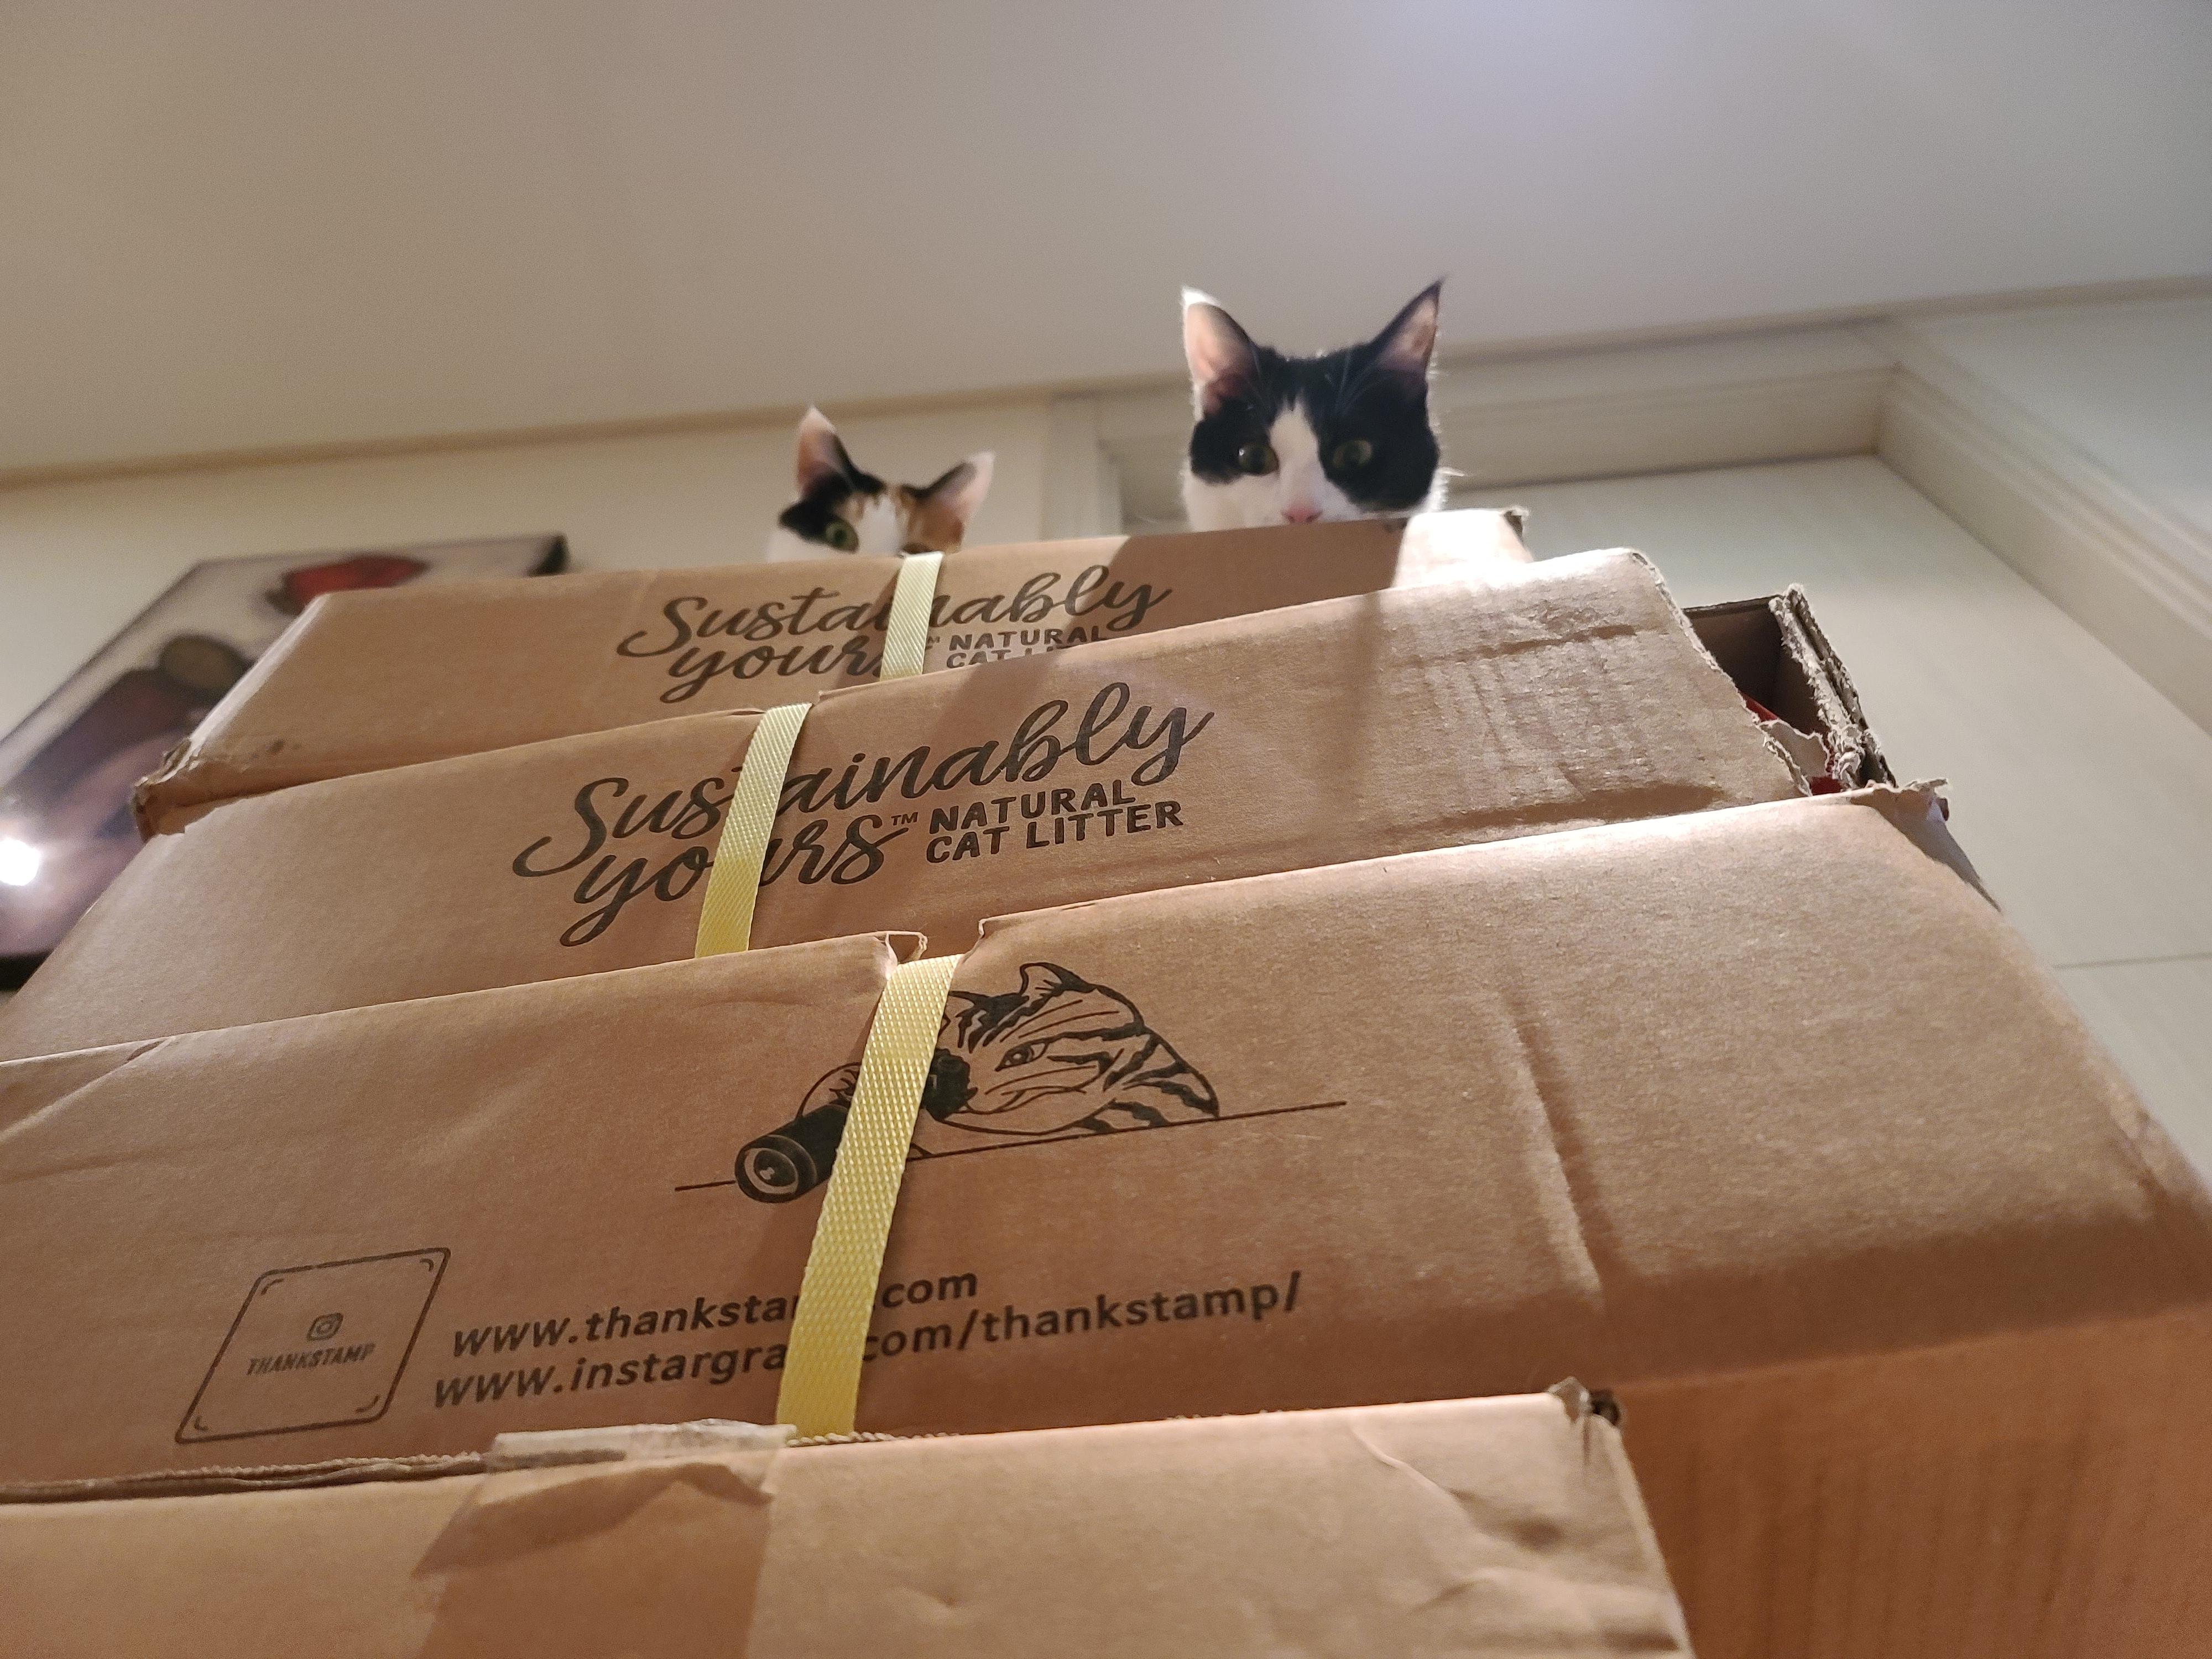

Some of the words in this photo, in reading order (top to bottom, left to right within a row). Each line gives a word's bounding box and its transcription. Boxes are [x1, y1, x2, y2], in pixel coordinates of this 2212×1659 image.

[660, 635, 885, 703] your
[949, 625, 1110, 651] NATURAL
[513, 682, 1215, 878] Susainably
[929, 779, 1136, 834] NATURAL
[926, 826, 1010, 863] CAT
[1026, 800, 1184, 849] LITTER
[453, 1271, 978, 1357] www.thankstacom
[246, 1343, 375, 1376] THANKSTAMP
